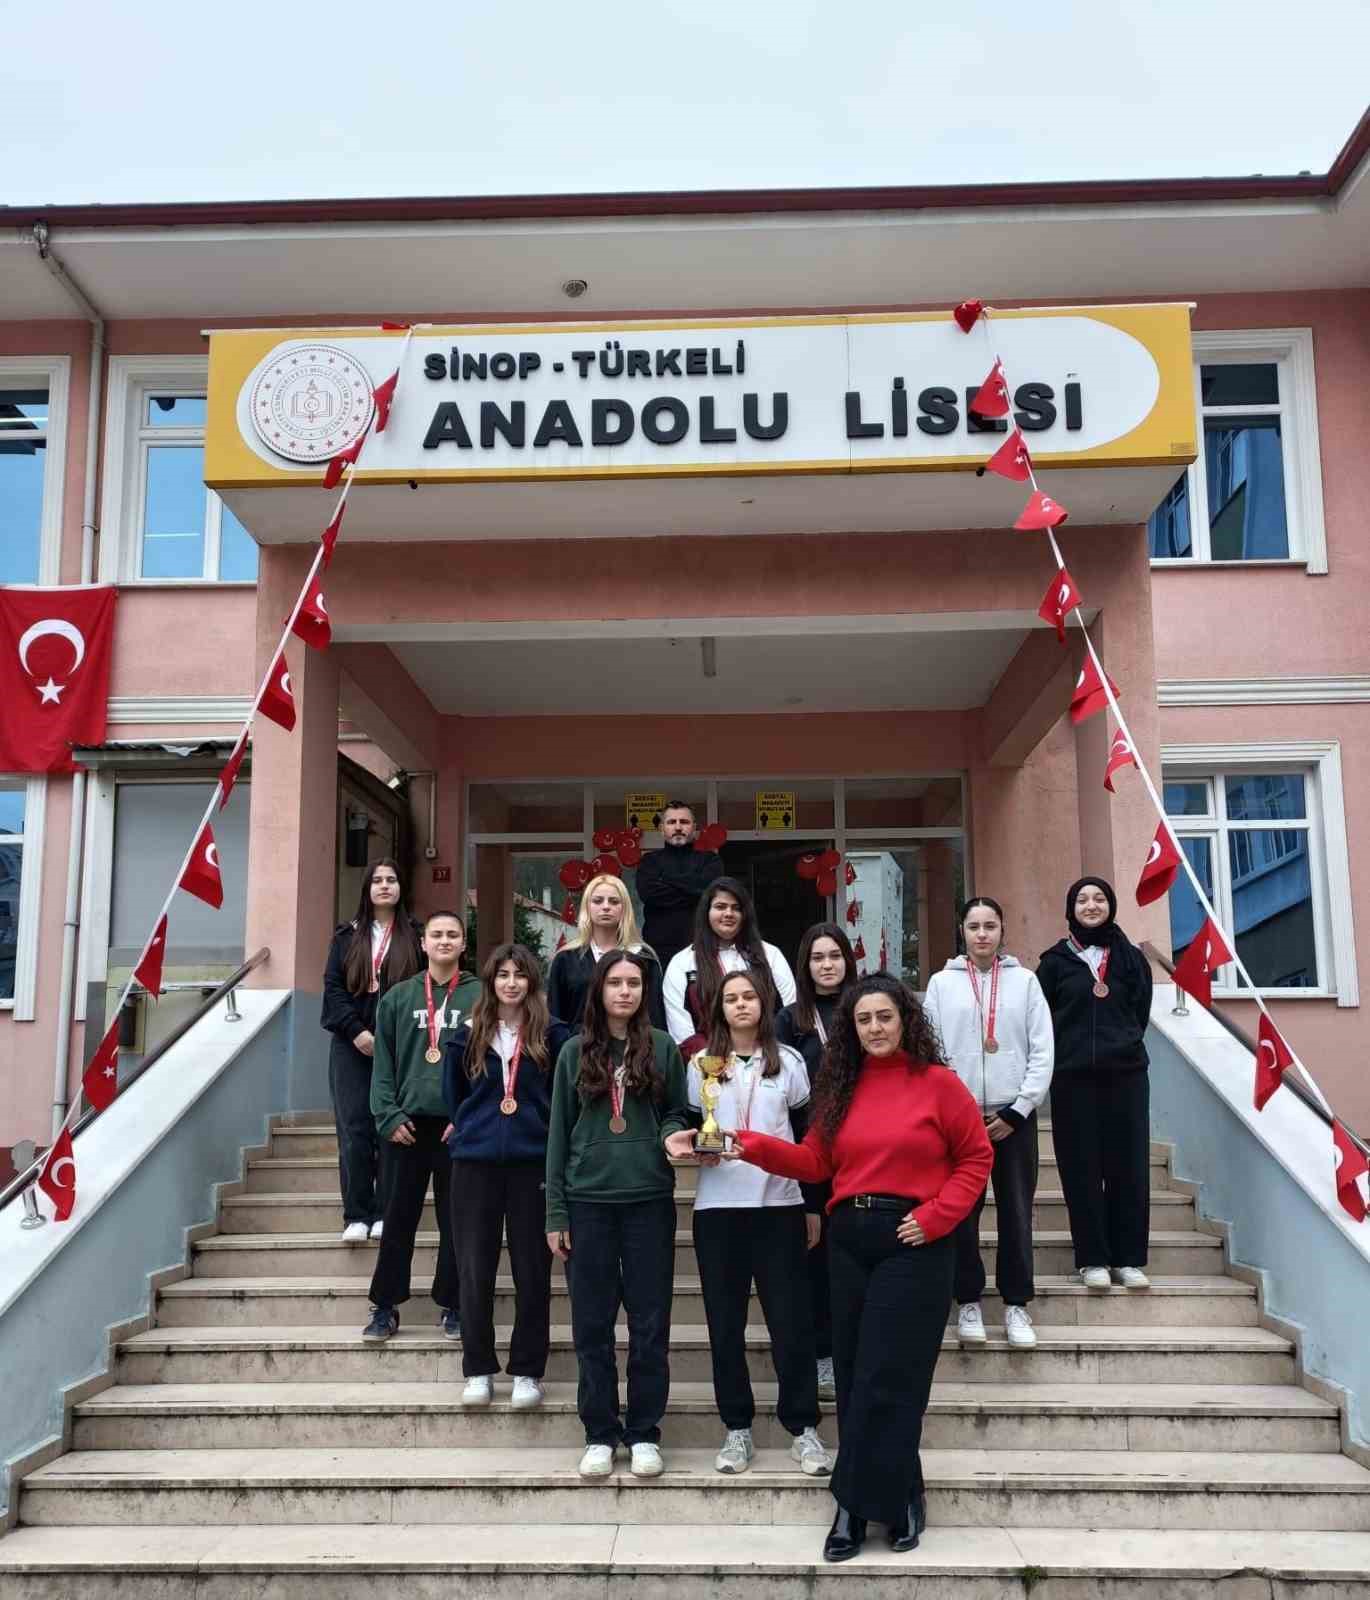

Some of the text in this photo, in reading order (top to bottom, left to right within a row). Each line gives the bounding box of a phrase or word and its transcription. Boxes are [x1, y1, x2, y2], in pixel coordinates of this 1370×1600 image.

[423, 346, 542, 381] SİNOP
[571, 339, 746, 379] TÜRKELİ
[422, 391, 789, 449] ANADOLU
